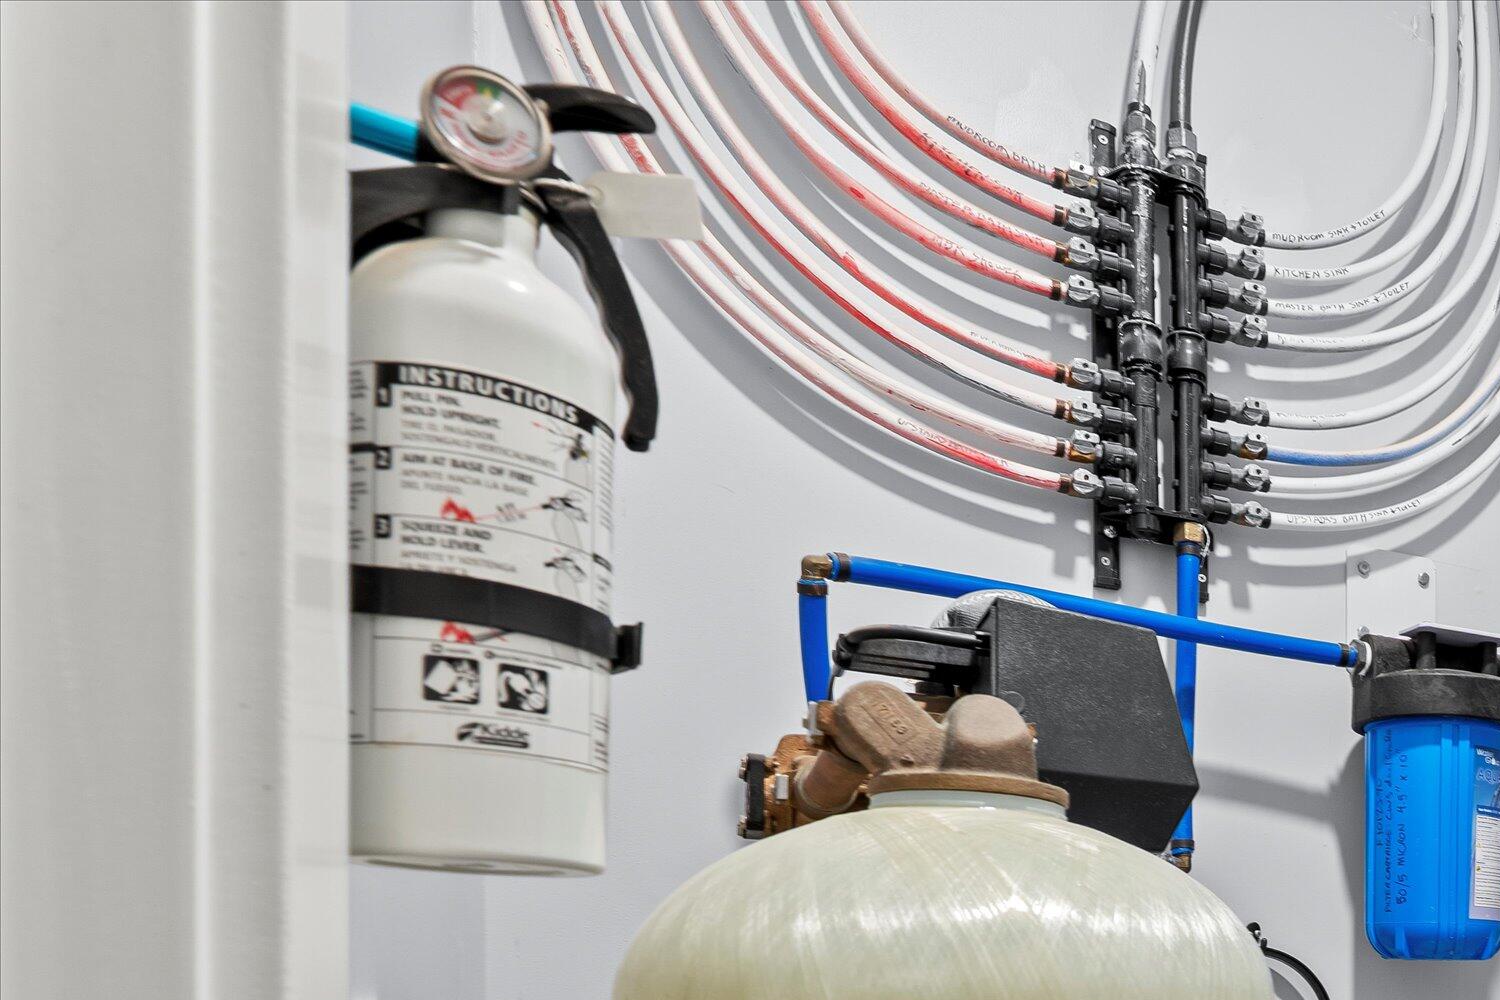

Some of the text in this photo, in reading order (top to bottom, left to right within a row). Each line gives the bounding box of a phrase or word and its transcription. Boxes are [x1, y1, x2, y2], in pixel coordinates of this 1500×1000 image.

[1012, 152, 1047, 176] BATH
[1272, 231, 1325, 243] MUDROOM
[1328, 226, 1349, 238] SINK
[1356, 209, 1386, 228] TOILET
[1273, 266, 1350, 279] KITCHEN SINK
[1351, 299, 1371, 310] SINK
[1382, 281, 1410, 299] TOILET
[401, 364, 579, 425] INSTRUCTIONS
[451, 457, 485, 474] BASE
[1342, 513, 1368, 523] BATH
[1396, 823, 1407, 867] MICRON
